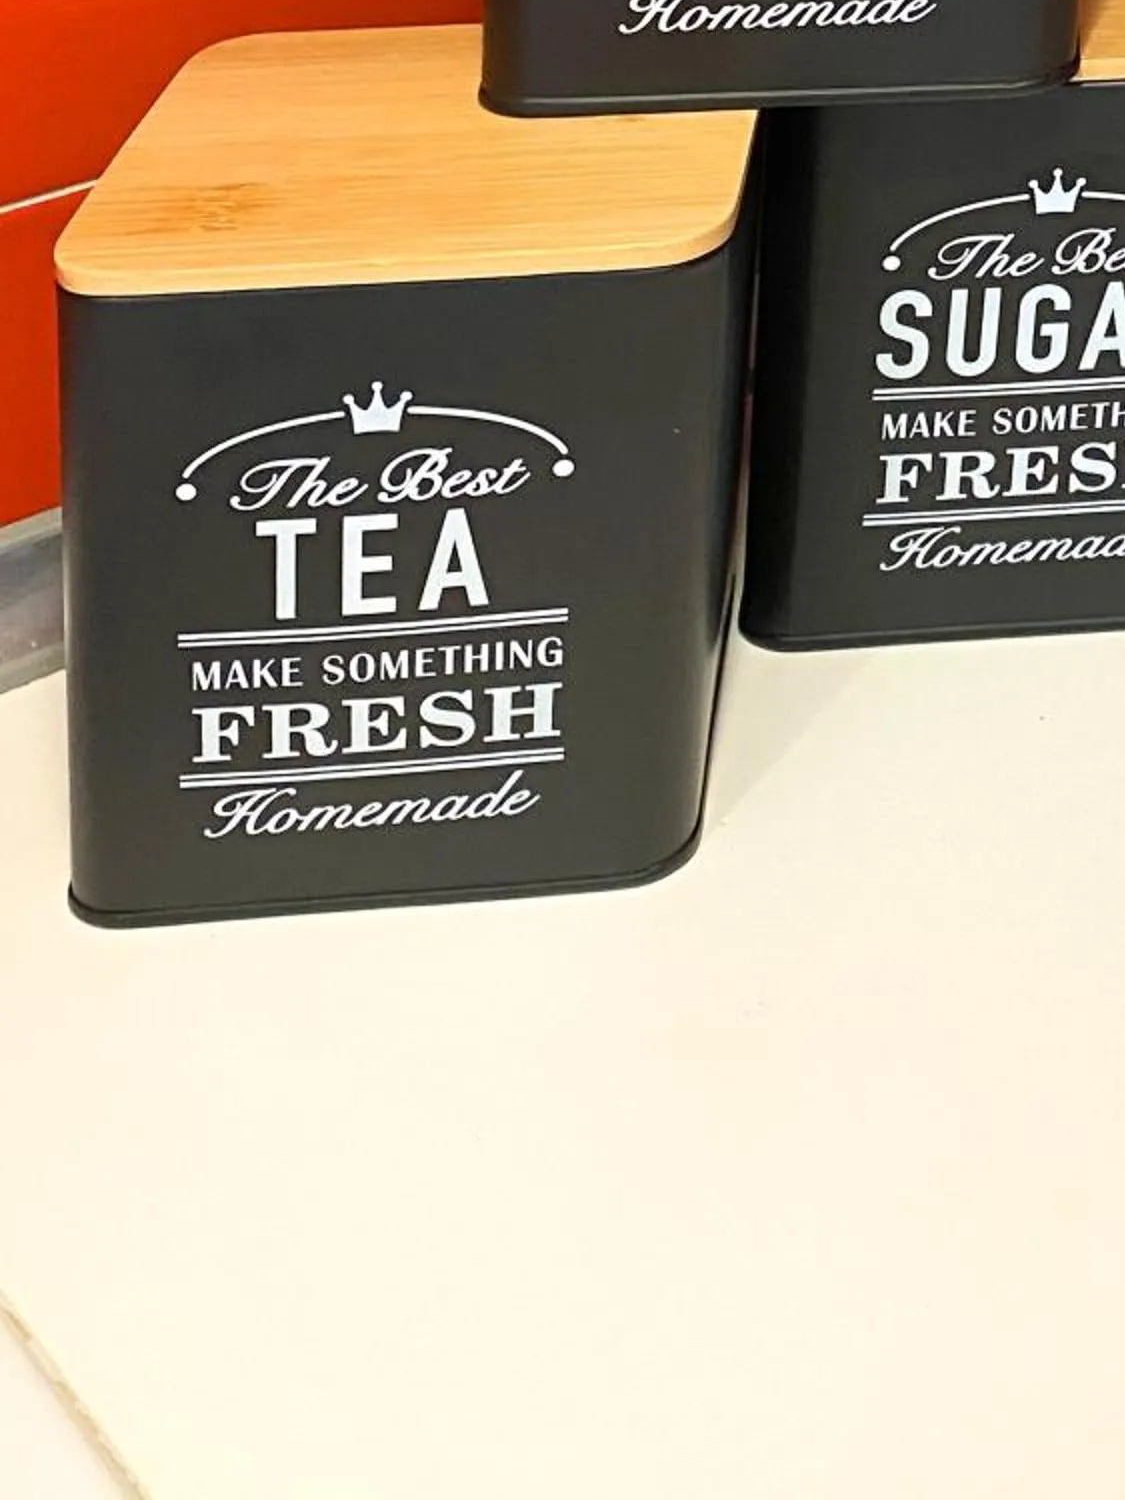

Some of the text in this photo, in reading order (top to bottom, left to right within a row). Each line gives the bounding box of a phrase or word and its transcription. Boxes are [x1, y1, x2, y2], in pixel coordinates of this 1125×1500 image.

[928, 233, 1044, 280] The
[881, 410, 977, 441] MAKE
[230, 447, 531, 511] The Best
[255, 507, 489, 620] TEA
[192, 636, 564, 691] MAKE SOMETHING
[192, 682, 563, 763] FRESH
[203, 769, 541, 838] Homemade
